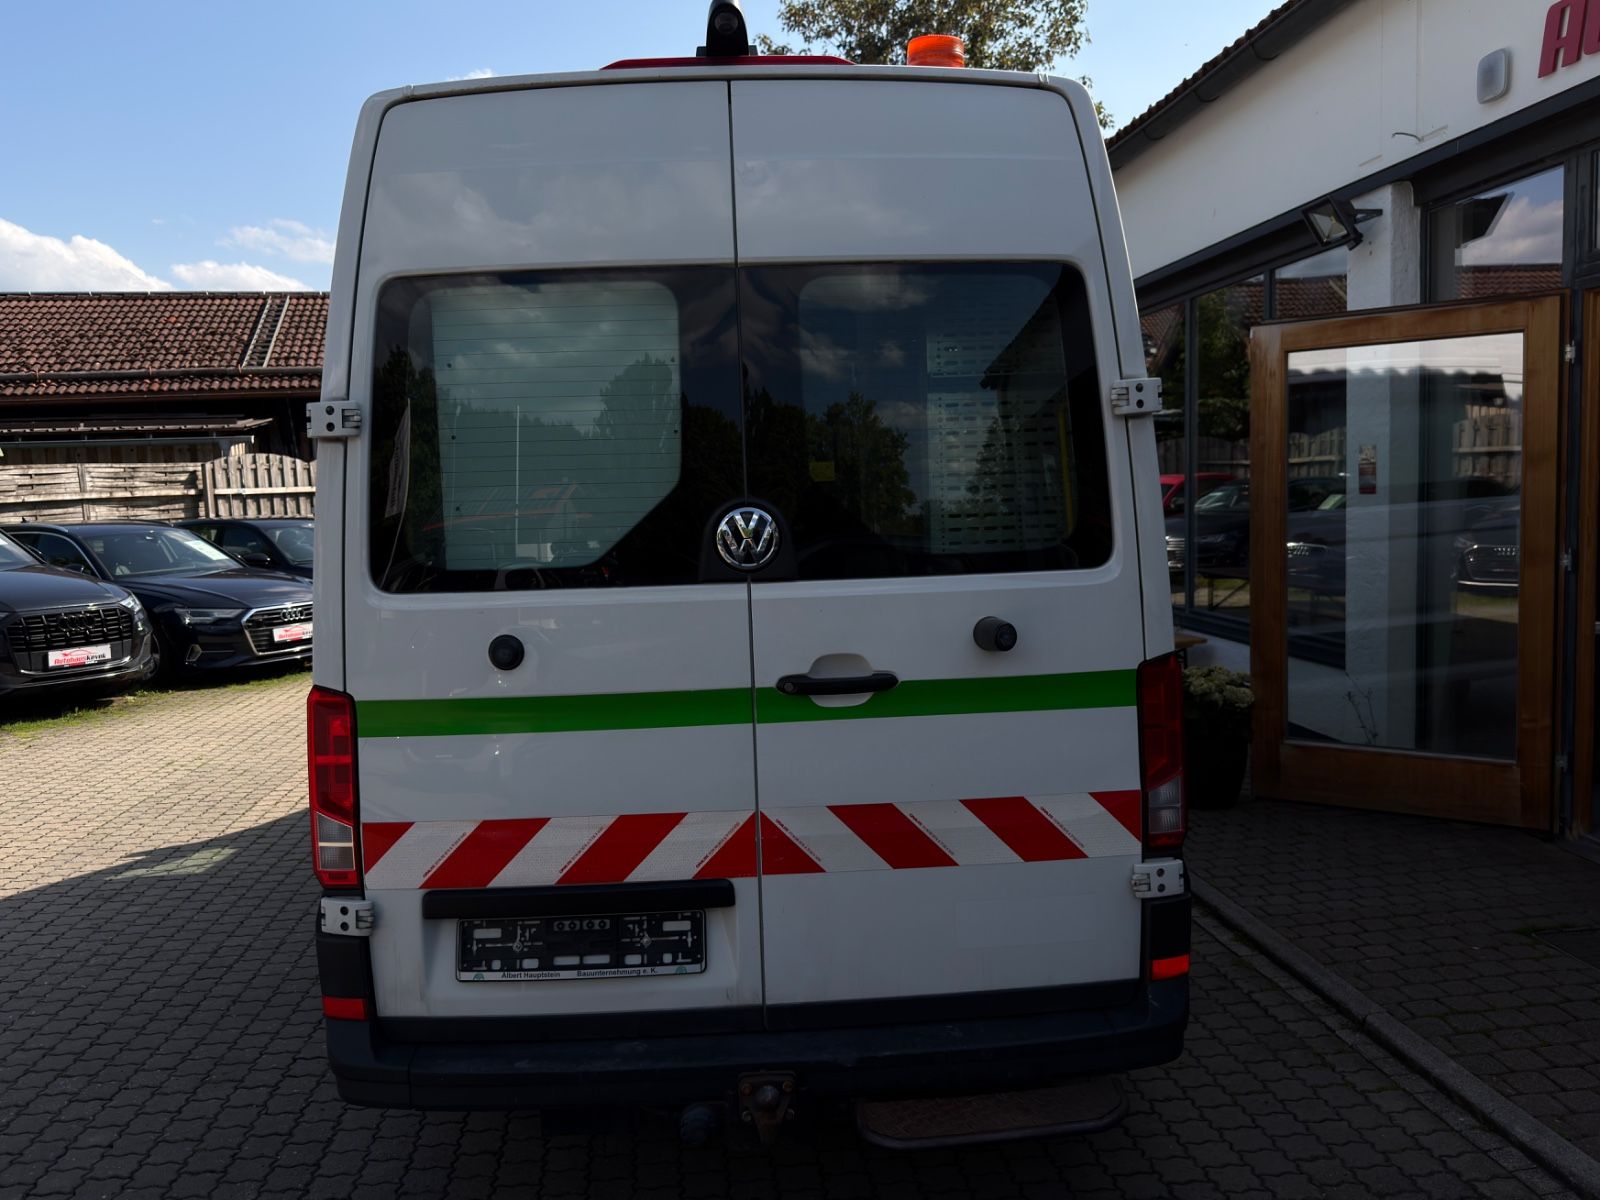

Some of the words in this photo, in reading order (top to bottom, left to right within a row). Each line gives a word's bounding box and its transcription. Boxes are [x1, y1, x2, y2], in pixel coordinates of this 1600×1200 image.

[718, 508, 777, 568] VW
[501, 971, 522, 979] Albert
[524, 971, 561, 979] Hauptstein
[577, 968, 641, 978] Bauunternehmung
